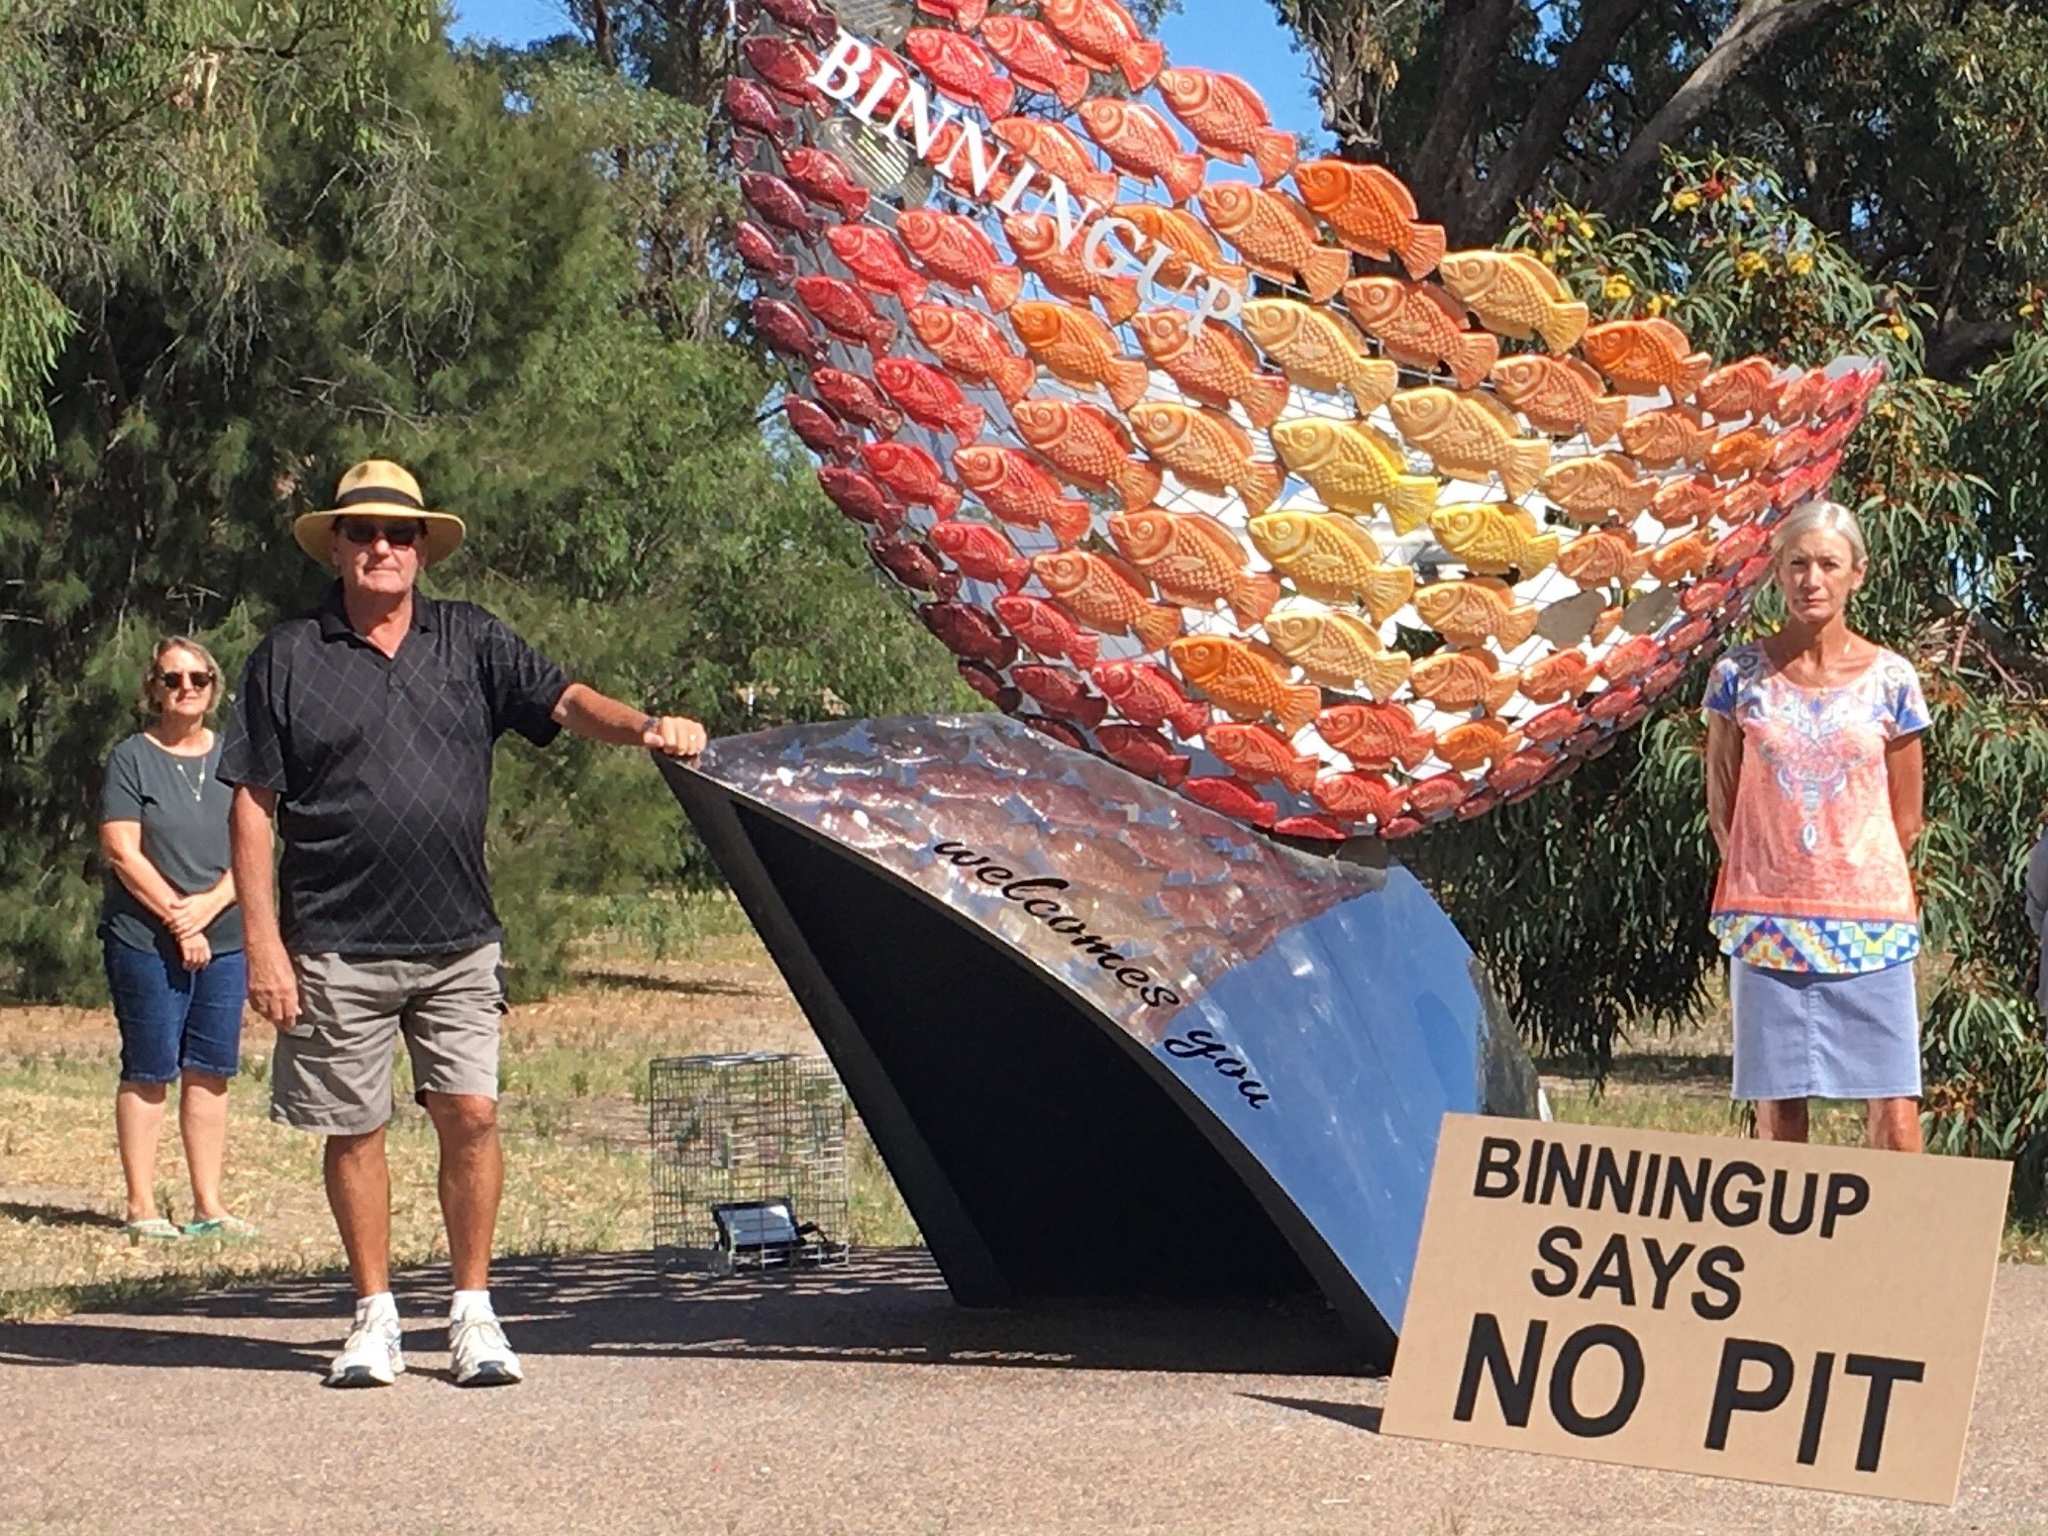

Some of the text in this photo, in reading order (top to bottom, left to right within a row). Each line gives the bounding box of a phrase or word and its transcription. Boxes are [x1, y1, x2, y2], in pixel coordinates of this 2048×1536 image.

[809, 28, 1243, 336] BINNINGUP
[934, 841, 1270, 1110] welcomes you
[1473, 1136, 1870, 1239] BINNINGUP
[1531, 1226, 1745, 1320] SAYS
[1453, 1312, 1926, 1473] NO PIT
